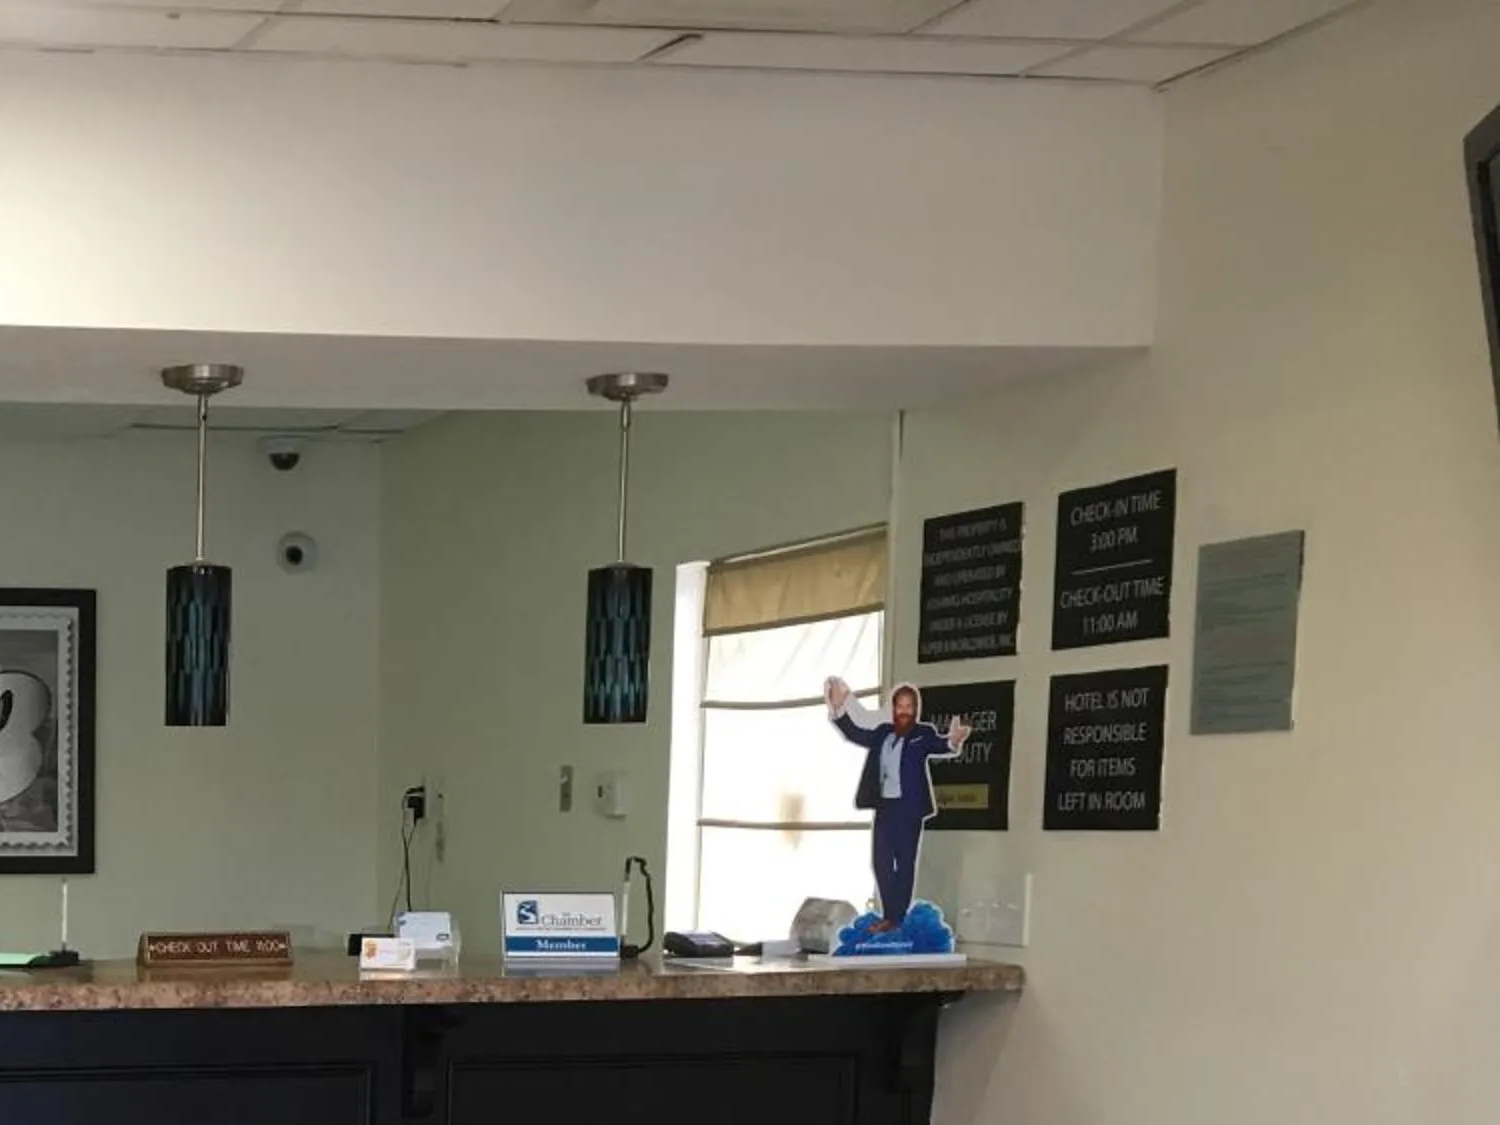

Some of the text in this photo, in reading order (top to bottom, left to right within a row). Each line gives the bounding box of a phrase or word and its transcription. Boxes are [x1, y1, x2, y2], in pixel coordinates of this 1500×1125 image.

[1132, 490, 1162, 514] TIME
[1118, 526, 1138, 545] PM
[1134, 576, 1164, 598] TIME
[1083, 610, 1138, 634] 11:00 AM
[1064, 688, 1150, 712] HOTEL IS NOT
[1063, 723, 1147, 745] RESPONSIBLE
[1070, 757, 1136, 777] FOR ITEMS
[1058, 790, 1145, 811] LEFT IN ROOM
[541, 913, 602, 926] Chamber
[155, 941, 190, 953] CHECK
[196, 941, 218, 953] OUT
[225, 940, 251, 953] TIME
[537, 939, 586, 949] Member
